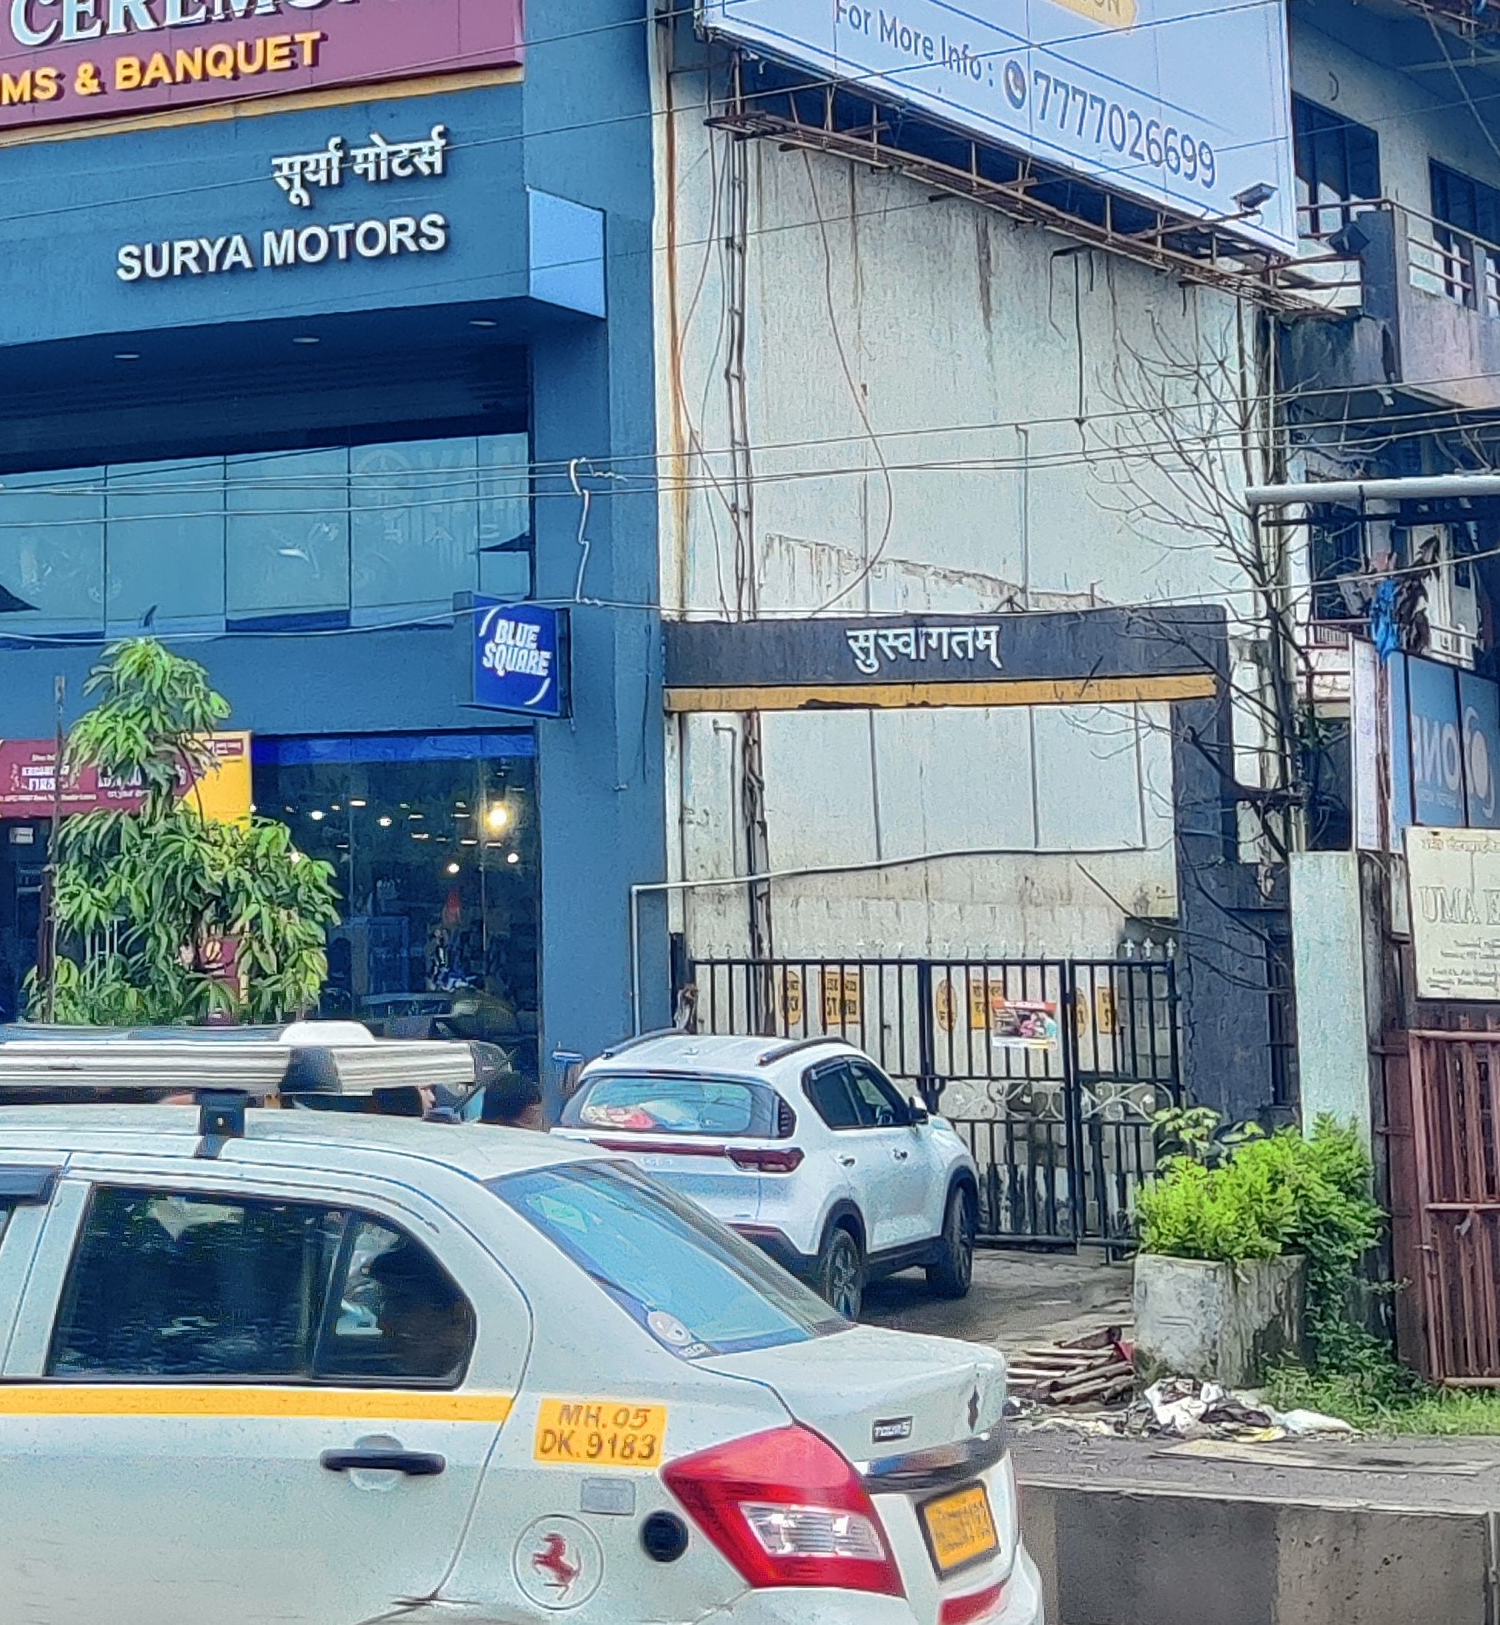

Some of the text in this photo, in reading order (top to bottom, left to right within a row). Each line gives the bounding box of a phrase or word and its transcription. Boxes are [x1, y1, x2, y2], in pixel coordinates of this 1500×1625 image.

[75, 64, 101, 96] &
[114, 31, 322, 93] BANQUET
[879, 9, 934, 61] More
[1035, 70, 1216, 189] 7777026699
[271, 124, 446, 207] सूर्या मोटर्स
[116, 213, 447, 282] SURYA MOTORS
[482, 639, 552, 677] SQUARE
[494, 618, 541, 650] BLUE
[845, 624, 1003, 674] सुस्वागतम्
[1418, 885, 1482, 925] UMA
